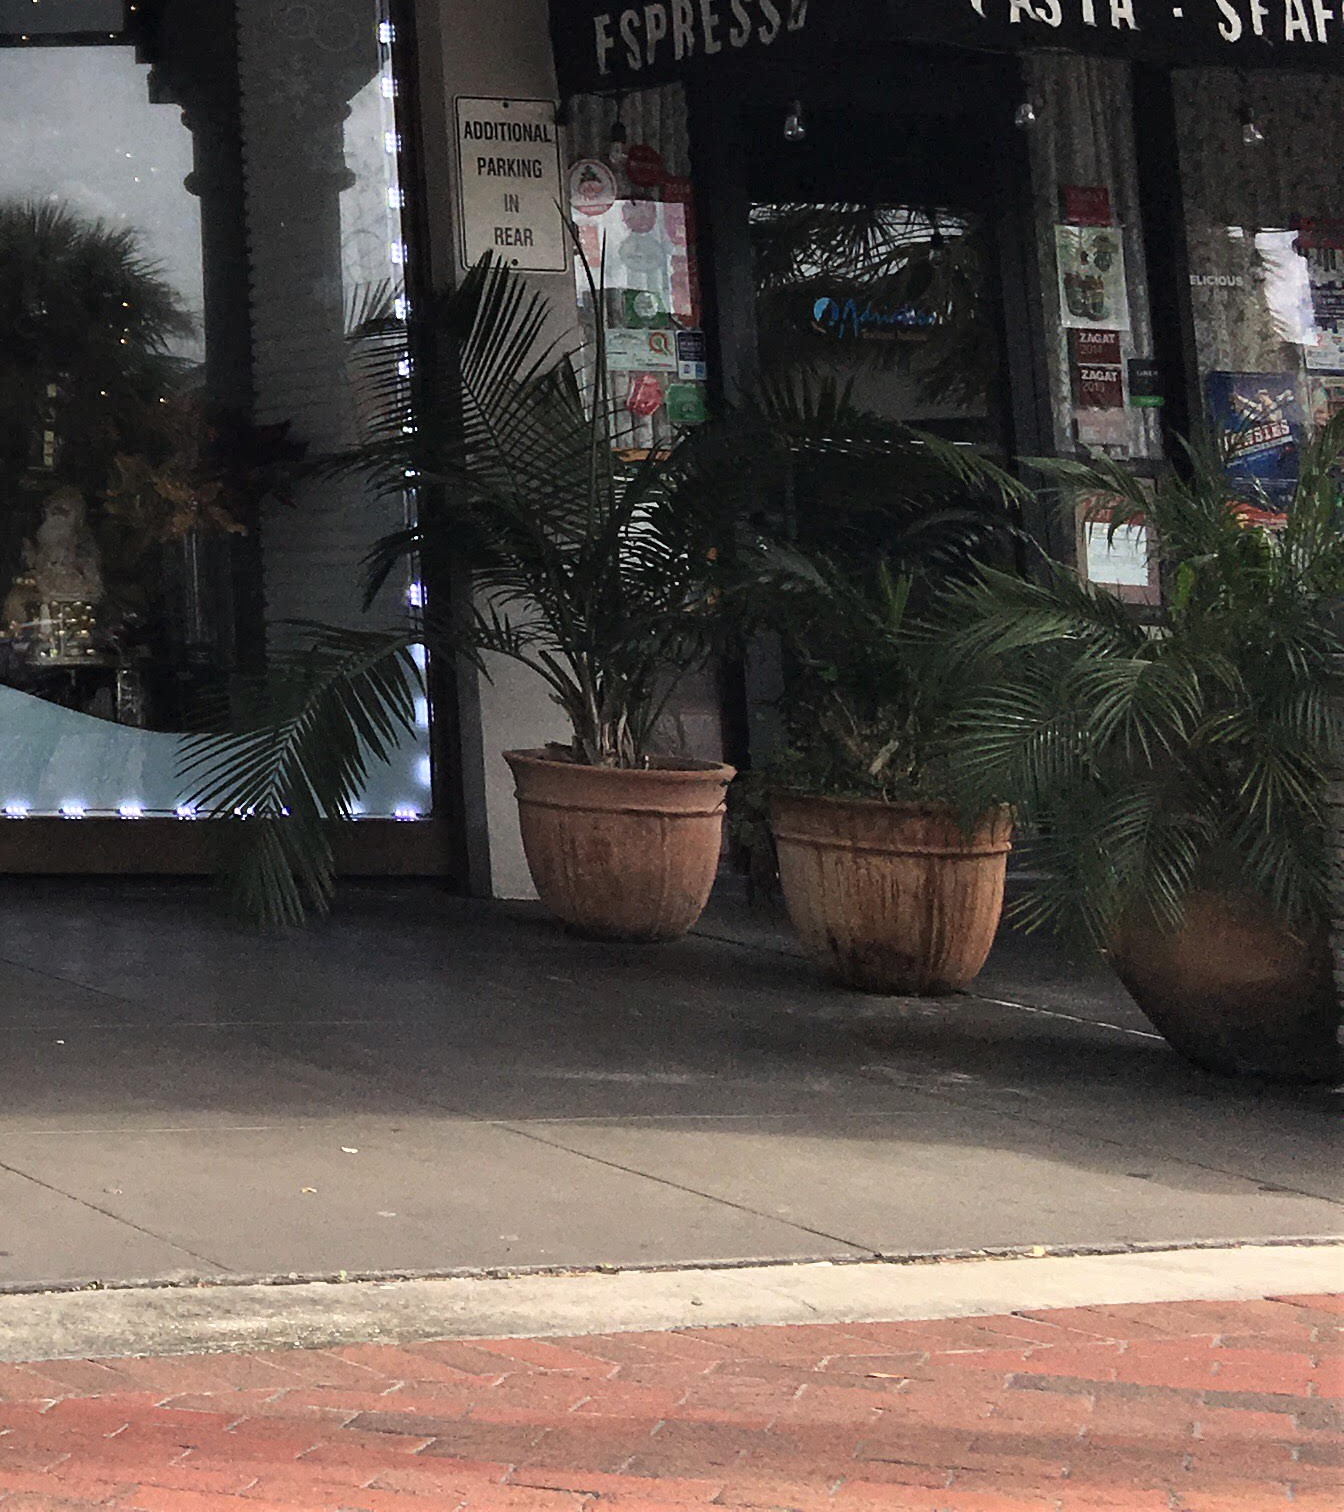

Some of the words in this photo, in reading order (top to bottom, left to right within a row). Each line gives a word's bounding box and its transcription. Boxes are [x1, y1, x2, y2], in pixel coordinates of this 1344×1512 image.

[463, 120, 553, 144] ADDITIONAL
[476, 157, 543, 179] PARKING
[504, 193, 519, 214] IN
[493, 226, 534, 248] REAR
[1189, 274, 1244, 287] ELICIOUS
[1079, 332, 1116, 344] ZAGAT
[1081, 369, 1118, 382] ZAGAT
